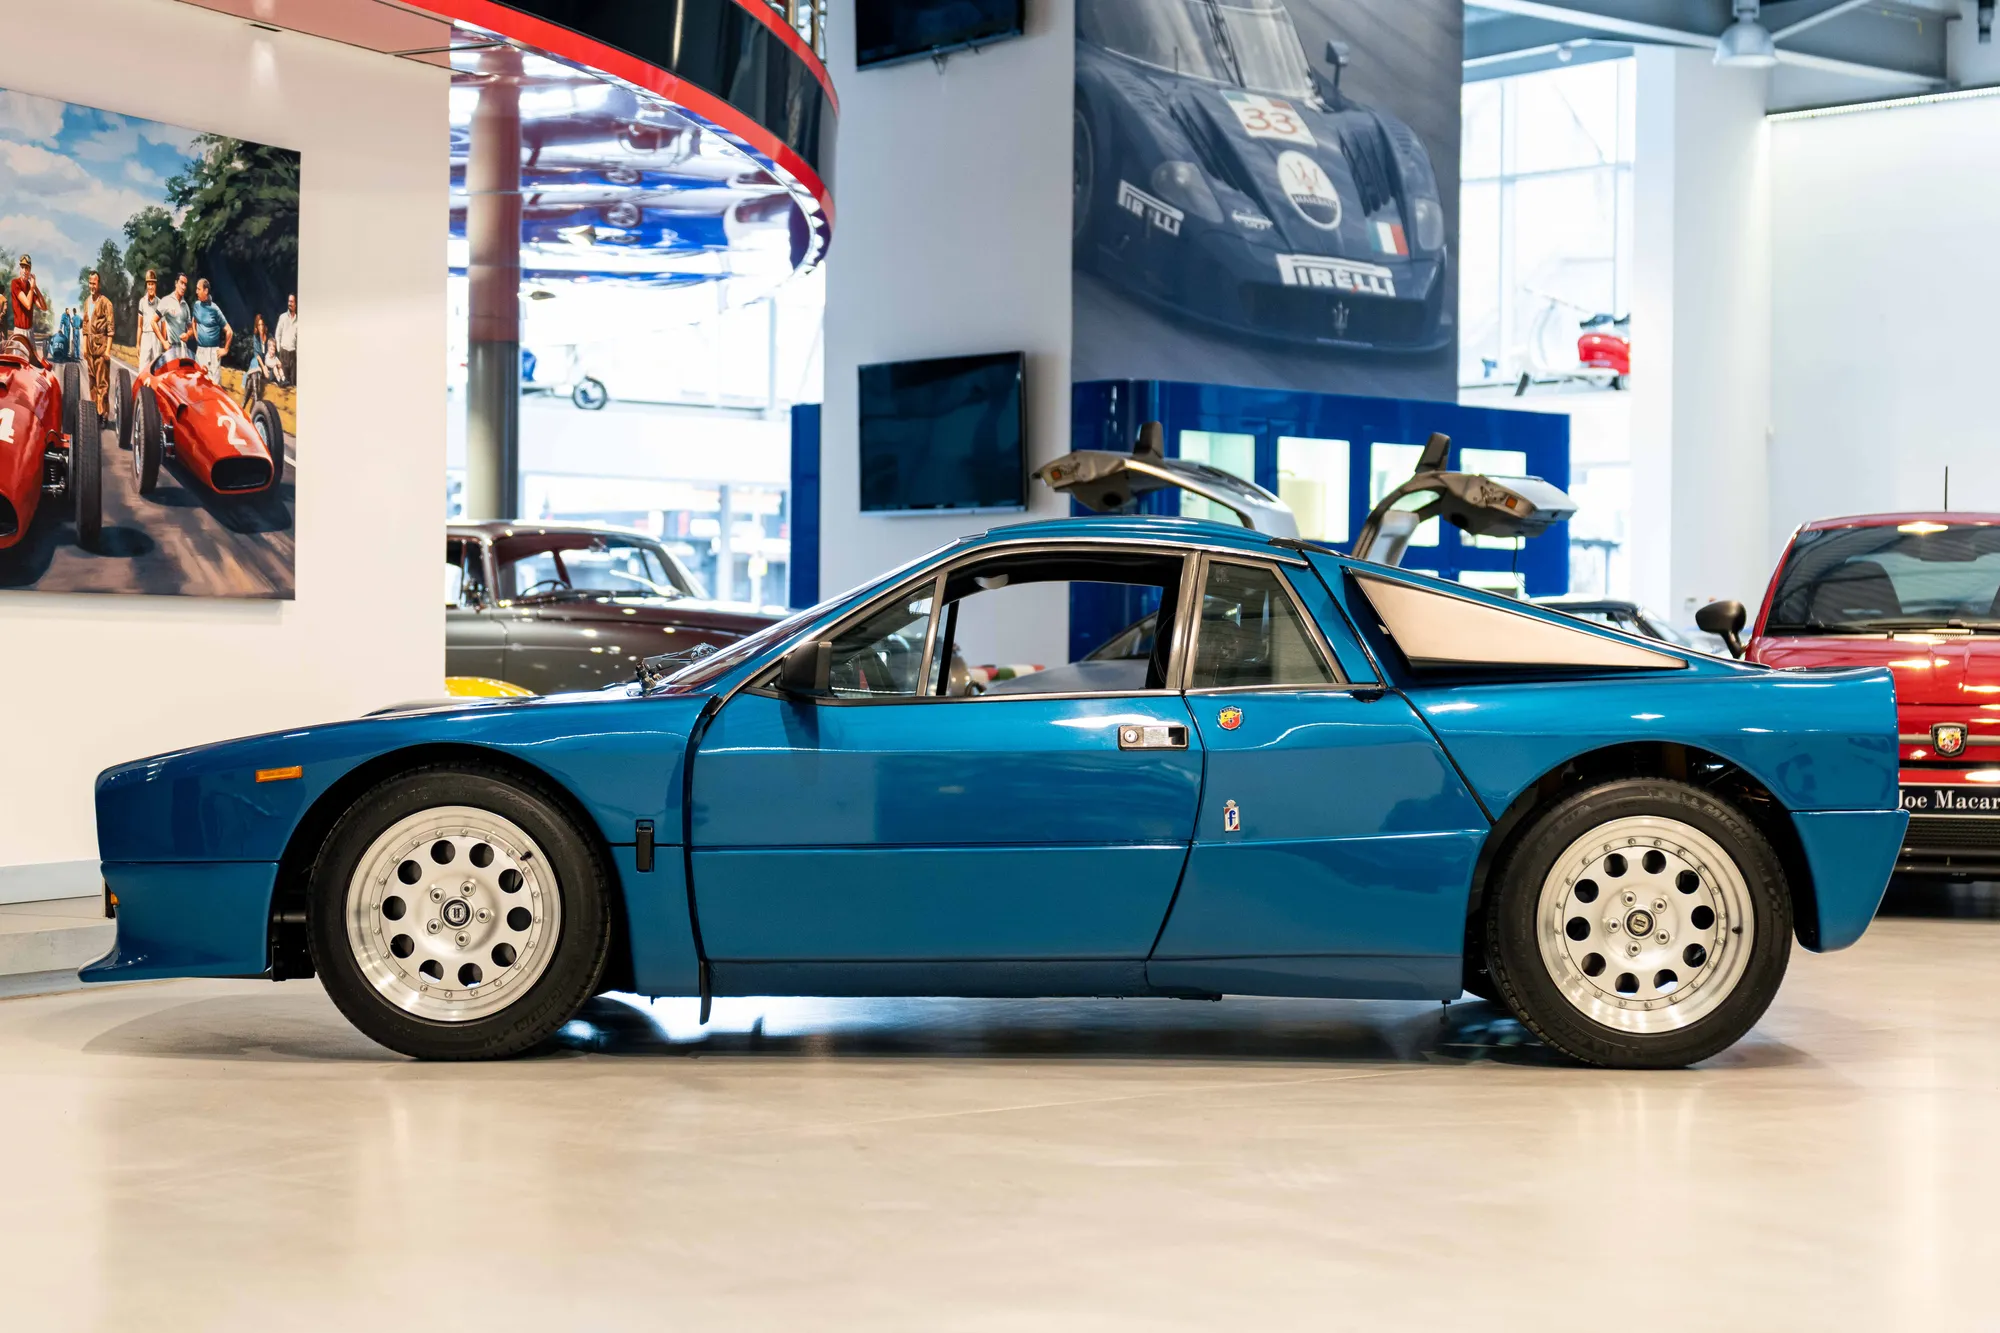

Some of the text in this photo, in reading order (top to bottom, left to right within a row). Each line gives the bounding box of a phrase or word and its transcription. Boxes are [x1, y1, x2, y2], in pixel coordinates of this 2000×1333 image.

[1243, 108, 1297, 135] 33
[1118, 179, 1184, 235] PIRLLI
[1276, 254, 1396, 297] PIRELLI
[217, 415, 247, 445] 2
[1897, 789, 2000, 809] Joe Macar
